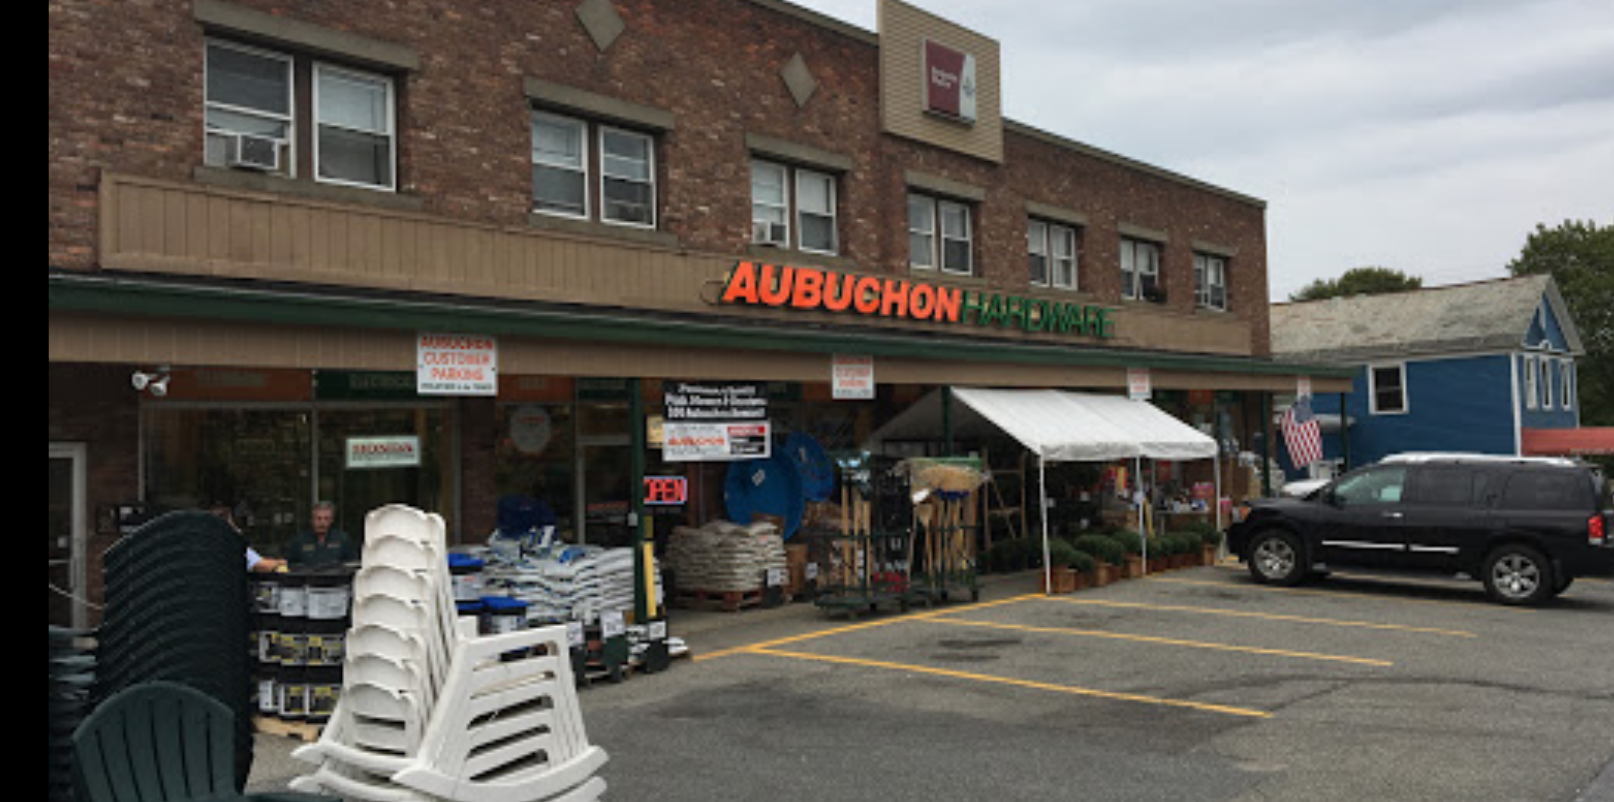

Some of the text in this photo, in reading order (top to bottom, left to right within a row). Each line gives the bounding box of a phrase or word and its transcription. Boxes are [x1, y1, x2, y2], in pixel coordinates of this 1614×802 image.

[722, 260, 1117, 339] AUBUCHON HARDWARE
[423, 351, 491, 366] CUSTOMER
[430, 367, 484, 381] PARKING
[643, 478, 686, 502] OPEN
